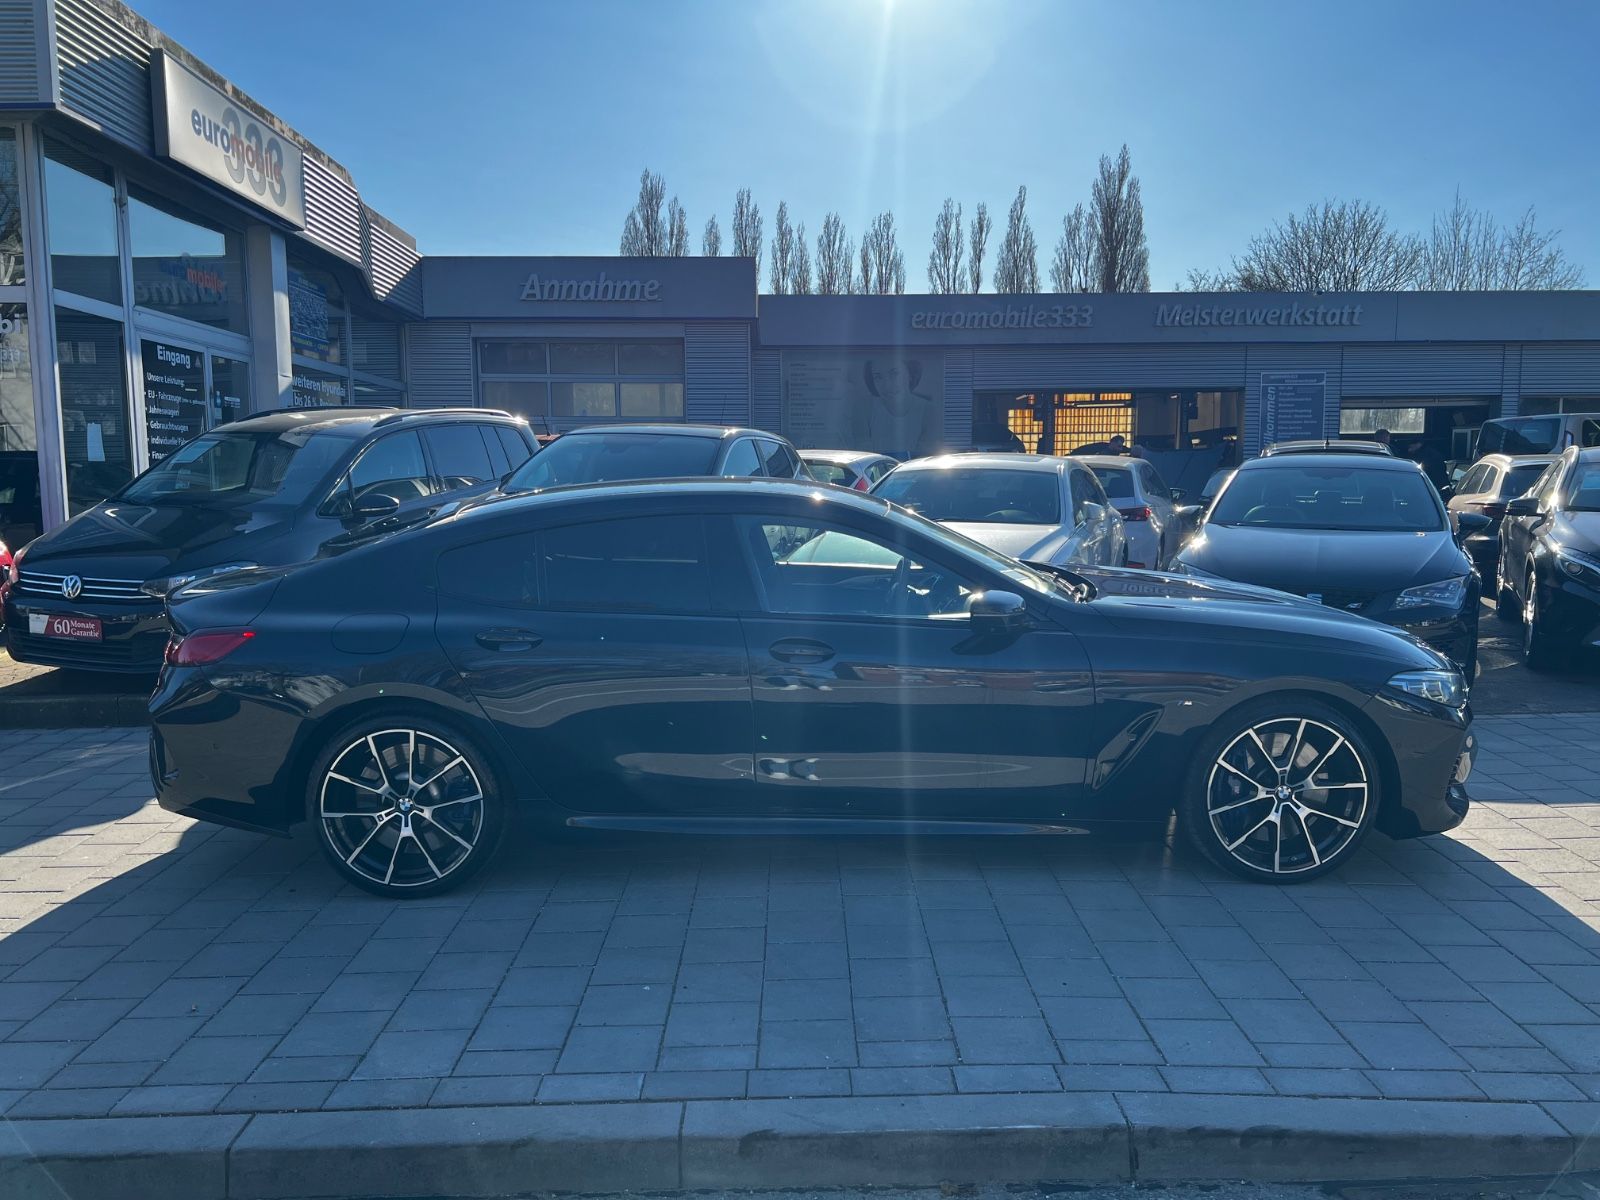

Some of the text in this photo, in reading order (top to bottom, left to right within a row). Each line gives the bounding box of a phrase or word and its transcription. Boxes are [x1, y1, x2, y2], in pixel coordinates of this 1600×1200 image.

[191, 108, 283, 185] euromobile
[221, 106, 287, 207] 333
[520, 271, 662, 302] Annahme
[910, 304, 1096, 330] euromobile333
[1154, 302, 1364, 328] Meisterwerkstatt
[156, 344, 191, 369] Eingang
[321, 380, 346, 397] Hyundai
[53, 619, 96, 634] 60 Monate
[70, 628, 99, 637] Garantie
